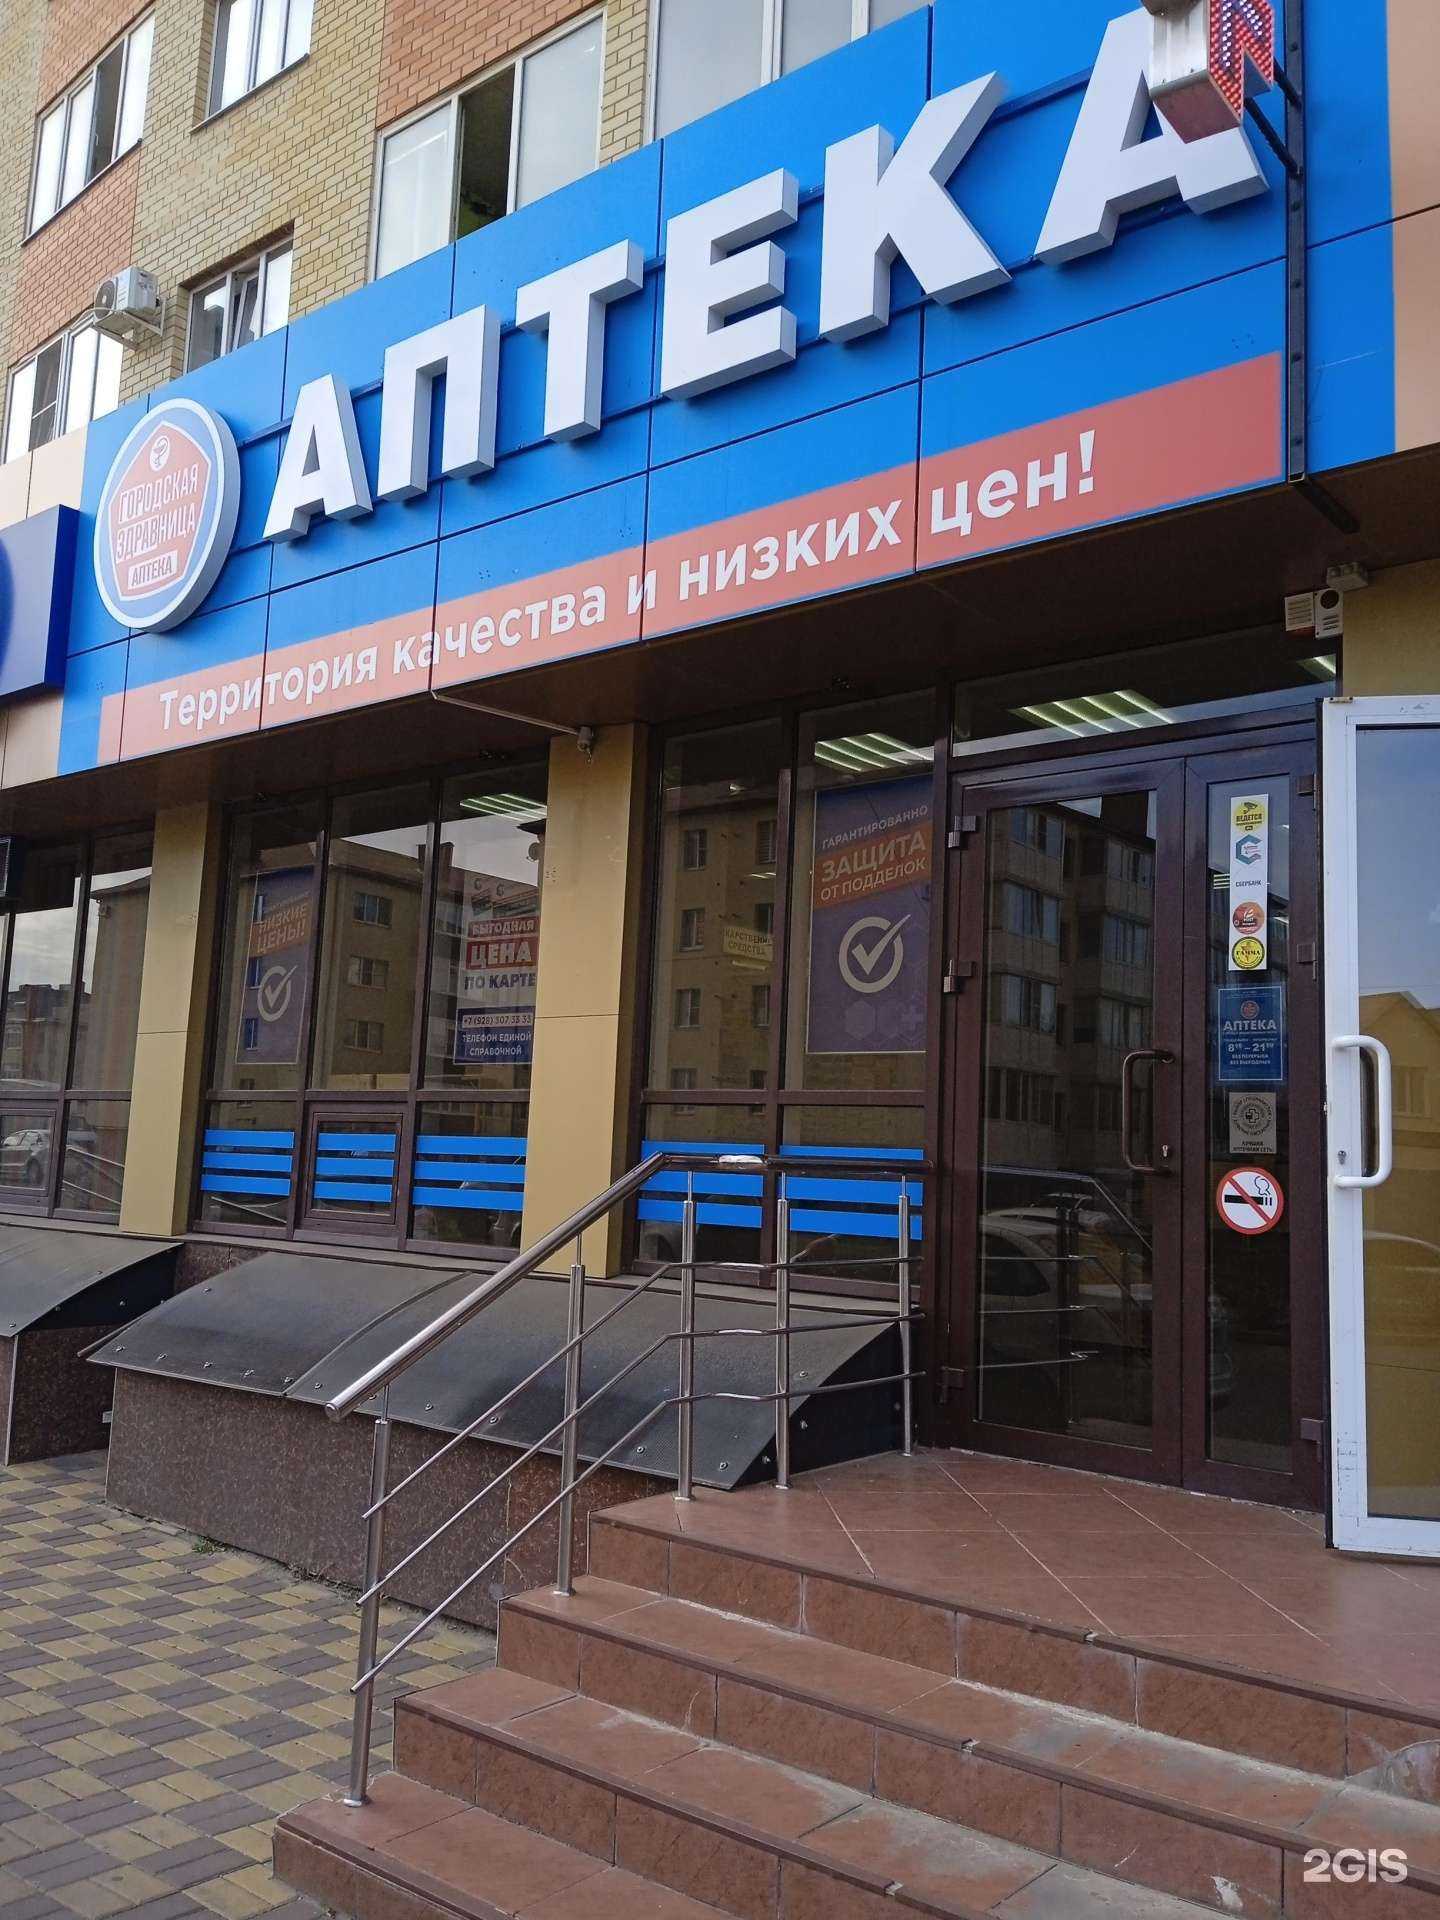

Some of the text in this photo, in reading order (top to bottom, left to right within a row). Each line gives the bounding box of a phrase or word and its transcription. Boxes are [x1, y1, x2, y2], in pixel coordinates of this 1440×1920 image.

[263, 6, 1269, 543] АПТЕКА
[118, 463, 199, 524] ГОРОДСКАЯ
[116, 503, 196, 562] ЗДРАВНИЦА
[131, 555, 173, 587] АПТЕКА
[160, 430, 1096, 730] Территория качества и низких цен!
[821, 804, 929, 850] ГАРАНТИРОВАННО
[820, 830, 926, 882] ЗАЩИТА
[820, 857, 926, 901] ОТ ПОДДЕЛОК
[1235, 880, 1262, 888] СБЕРБАНК
[472, 919, 534, 936] ВЫГОДНАЯ
[470, 941, 532, 968] ЦЕНА
[464, 973, 536, 990] ПО КАРТЕ
[462, 1031, 532, 1042] ТЕЛЕФОН ЕДИНОЙ
[1223, 1017, 1278, 1031] АПТЕКА
[469, 1045, 522, 1056] СПРАВОЧНОЙ
